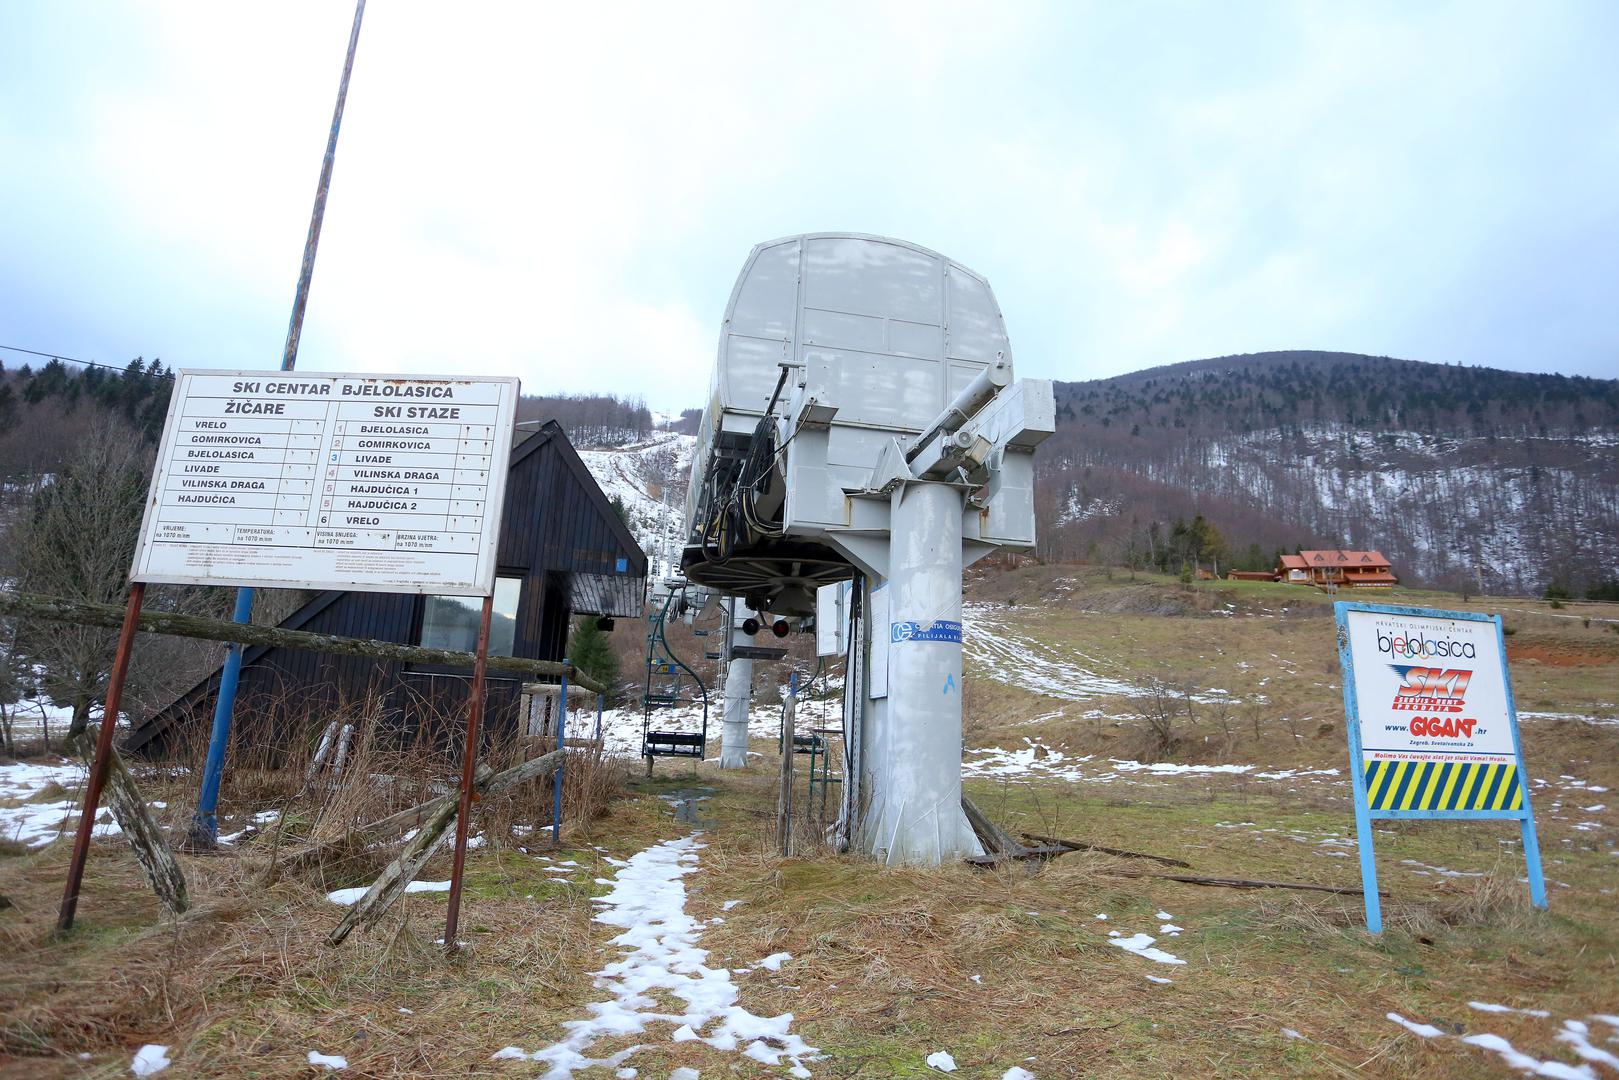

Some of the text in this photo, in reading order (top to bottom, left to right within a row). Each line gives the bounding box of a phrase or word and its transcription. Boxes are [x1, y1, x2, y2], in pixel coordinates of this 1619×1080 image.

[232, 381, 454, 398] SKI CENTAR BJELOLASICA
[224, 399, 286, 415] ŽIČARE
[373, 405, 461, 420] SKI STAZE
[195, 421, 227, 429] VRELO
[337, 425, 430, 435] 1 BJELOLASICA
[191, 435, 262, 445] GOMIRKOVICA
[333, 439, 431, 450] 2 GOMIRKOVICA
[187, 450, 255, 459] BJELOLASICA
[330, 453, 392, 464] 3 LIVADE
[184, 465, 220, 473] LIVADE
[327, 469, 440, 480] 4 VILINSKA DRAGA
[182, 479, 265, 490] VILINSKA DRAGA
[325, 484, 418, 495] 5 HAJDUČICA 1
[177, 493, 236, 504] HAJDUČICA
[323, 499, 417, 510] 5 HAJDUČICA 2
[320, 516, 380, 526] 6 VRELO
[236, 527, 276, 535] TEMPERATURA:
[1375, 621, 1407, 629] HRVATSKI
[1409, 623, 1446, 632] OLIMPIJSKI
[1376, 629, 1476, 659] bjelolasica
[1397, 666, 1474, 699] SKI
[1398, 696, 1429, 705] SERVIS
[1396, 703, 1450, 712] PRODAJA
